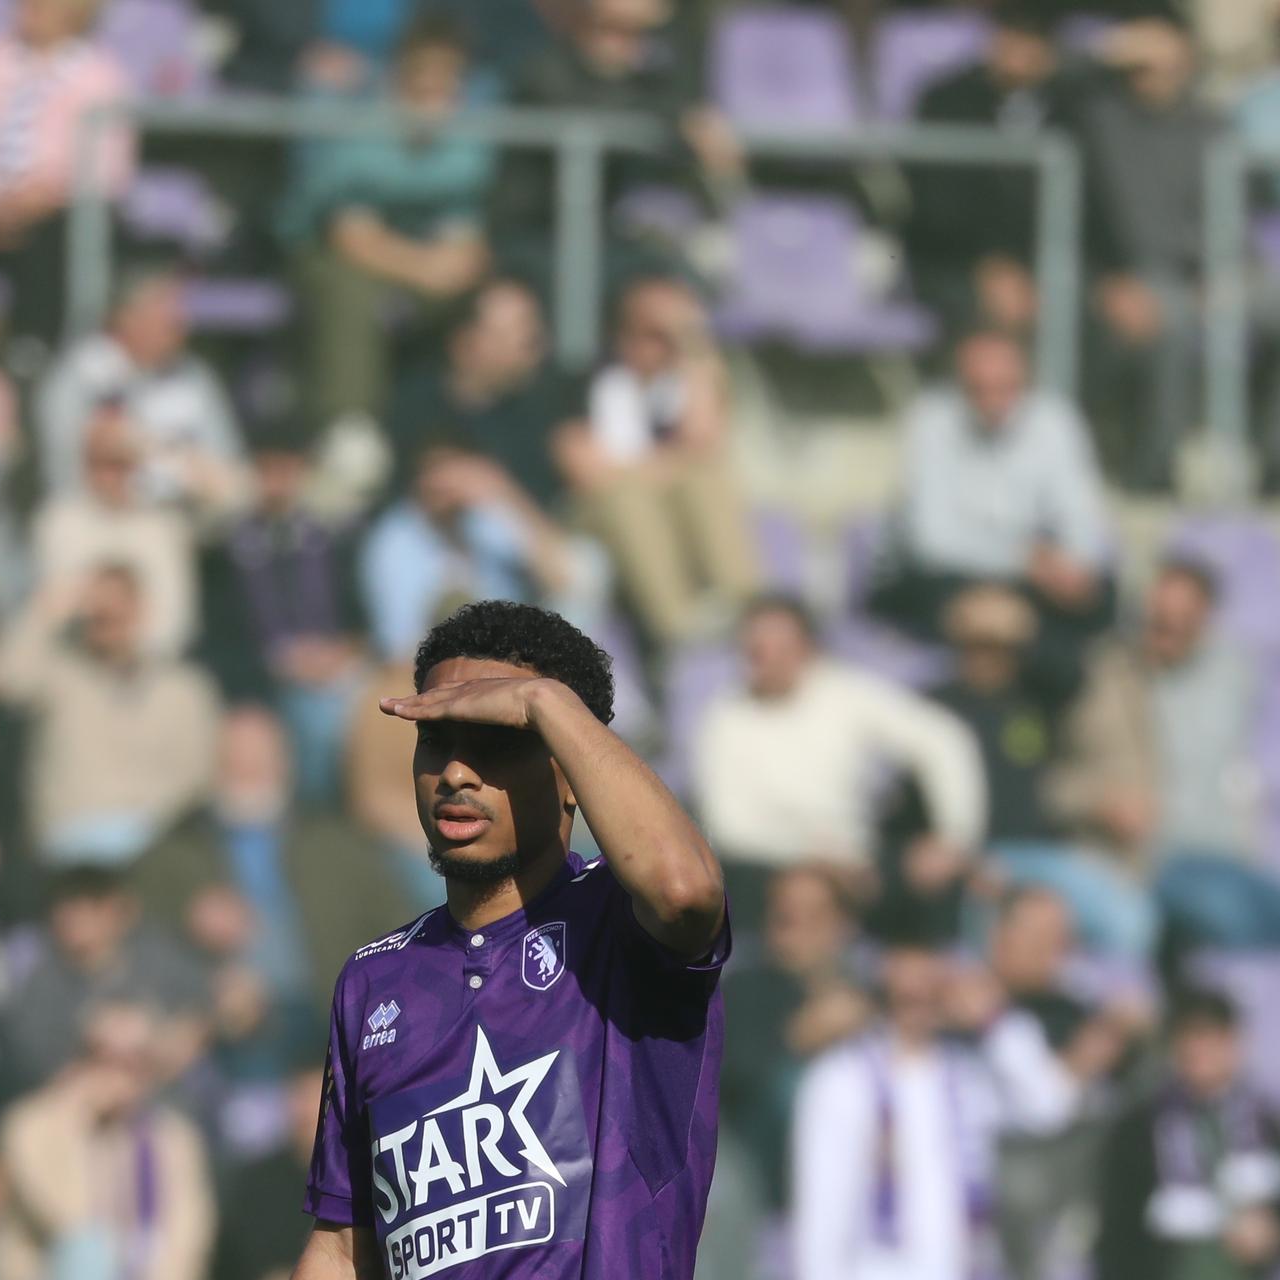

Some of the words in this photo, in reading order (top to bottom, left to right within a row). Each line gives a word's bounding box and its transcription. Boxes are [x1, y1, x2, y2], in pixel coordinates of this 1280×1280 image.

[355, 941, 402, 961] LUBRICANTS
[371, 1103, 522, 1224] STAR
[495, 1197, 542, 1235] TV
